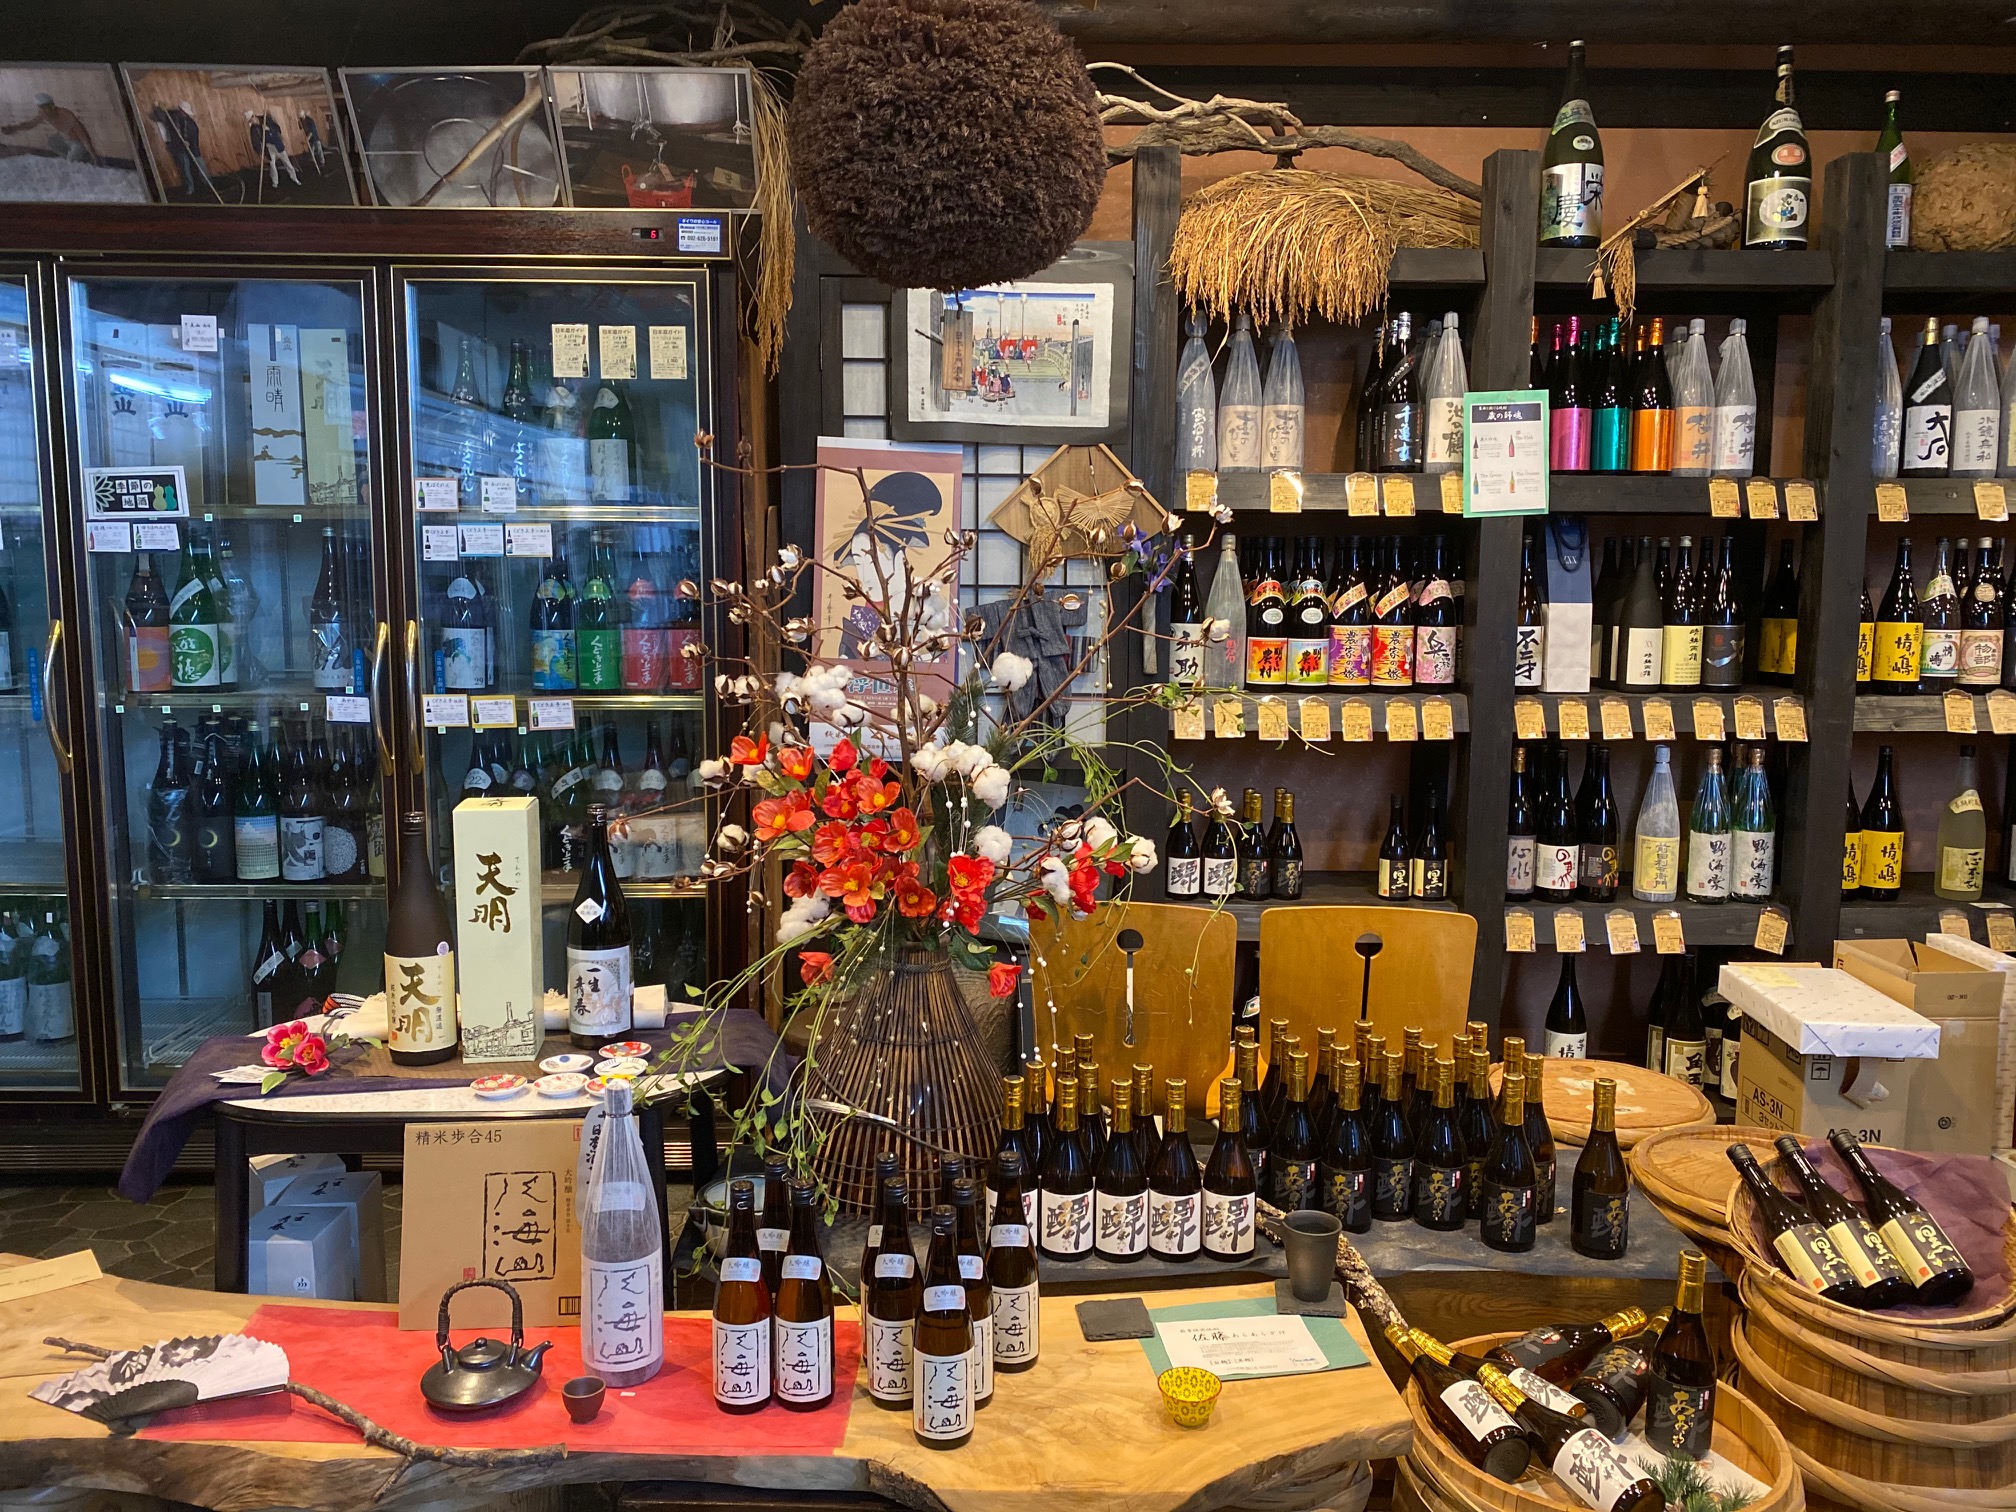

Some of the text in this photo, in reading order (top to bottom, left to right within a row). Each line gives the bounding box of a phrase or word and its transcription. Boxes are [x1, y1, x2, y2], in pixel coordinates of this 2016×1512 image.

[117, 481, 153, 493] 季節の
[124, 496, 148, 507] 地酒
[1515, 628, 1539, 682] 不二才
[468, 851, 520, 934] 天明
[395, 962, 443, 1044] 天明
[1752, 1087, 1784, 1120] AS-3N
[414, 1128, 503, 1146] 精米歩合45
[1826, 1128, 1882, 1143] A-3N
